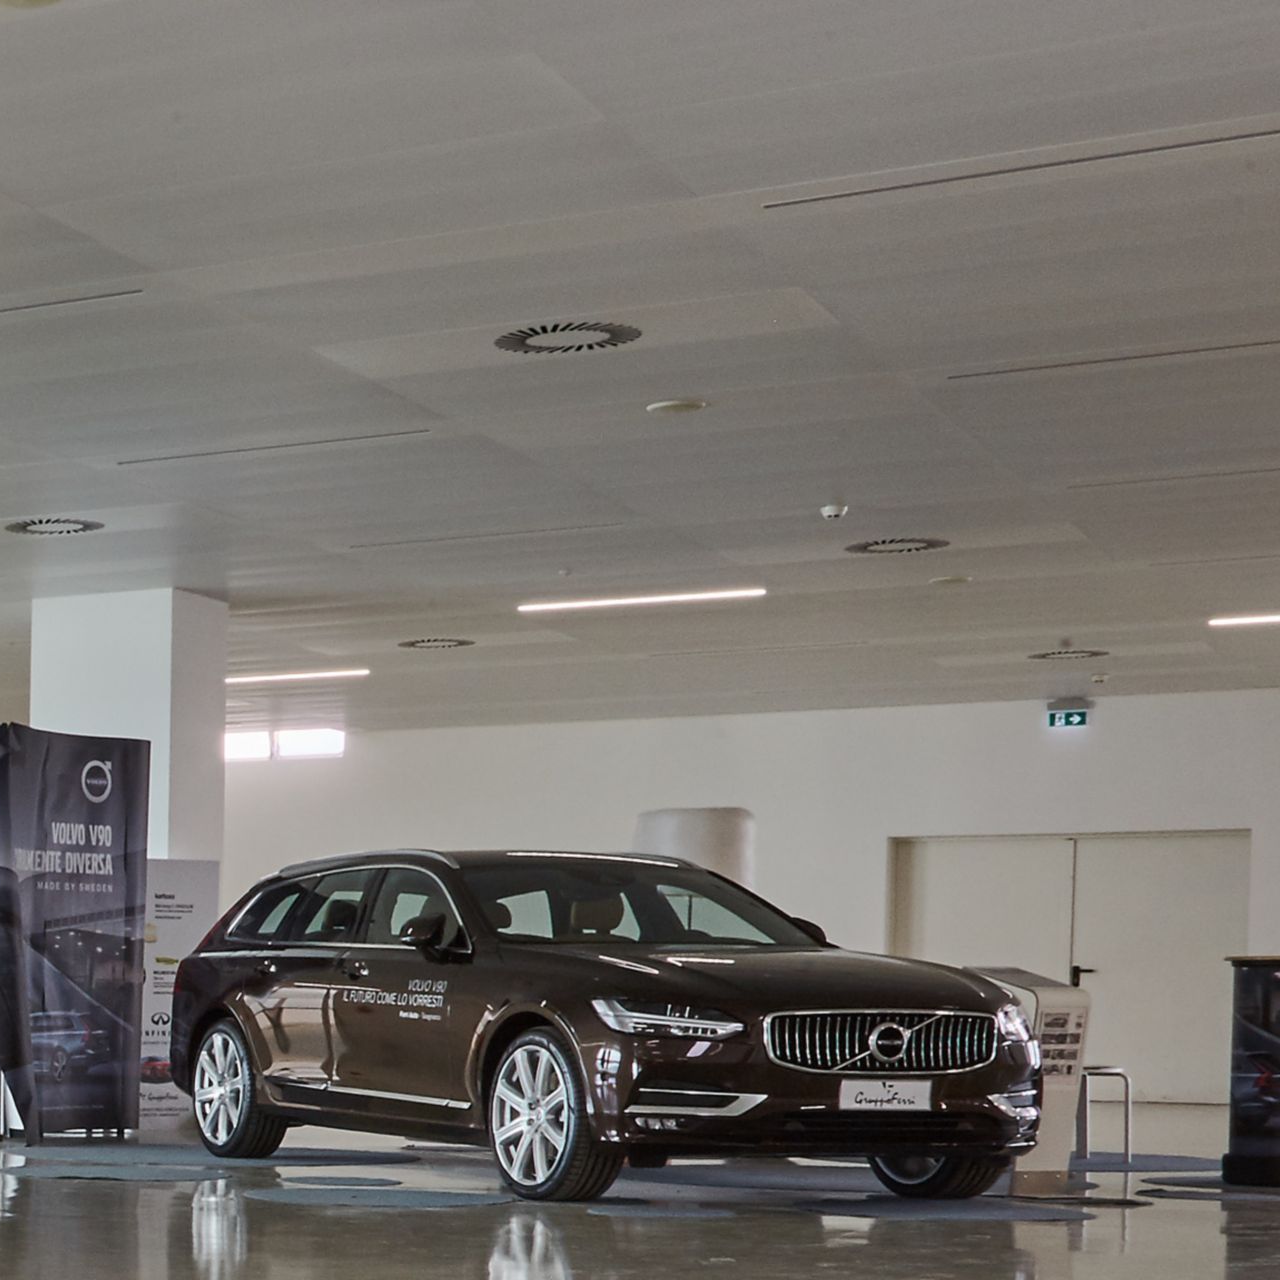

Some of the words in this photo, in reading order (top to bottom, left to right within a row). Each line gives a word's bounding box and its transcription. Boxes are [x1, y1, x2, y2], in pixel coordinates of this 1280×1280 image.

[51, 822, 85, 846] VOLVO
[89, 825, 112, 848] V90
[65, 852, 113, 875] DIVERSA
[36, 881, 60, 890] MADE
[79, 883, 113, 893] SWEDEN
[408, 980, 432, 992] VOLVO
[432, 981, 448, 993] V90
[350, 991, 376, 1003] FUTURO
[377, 992, 397, 1005] COME
[397, 993, 408, 1006] LO
